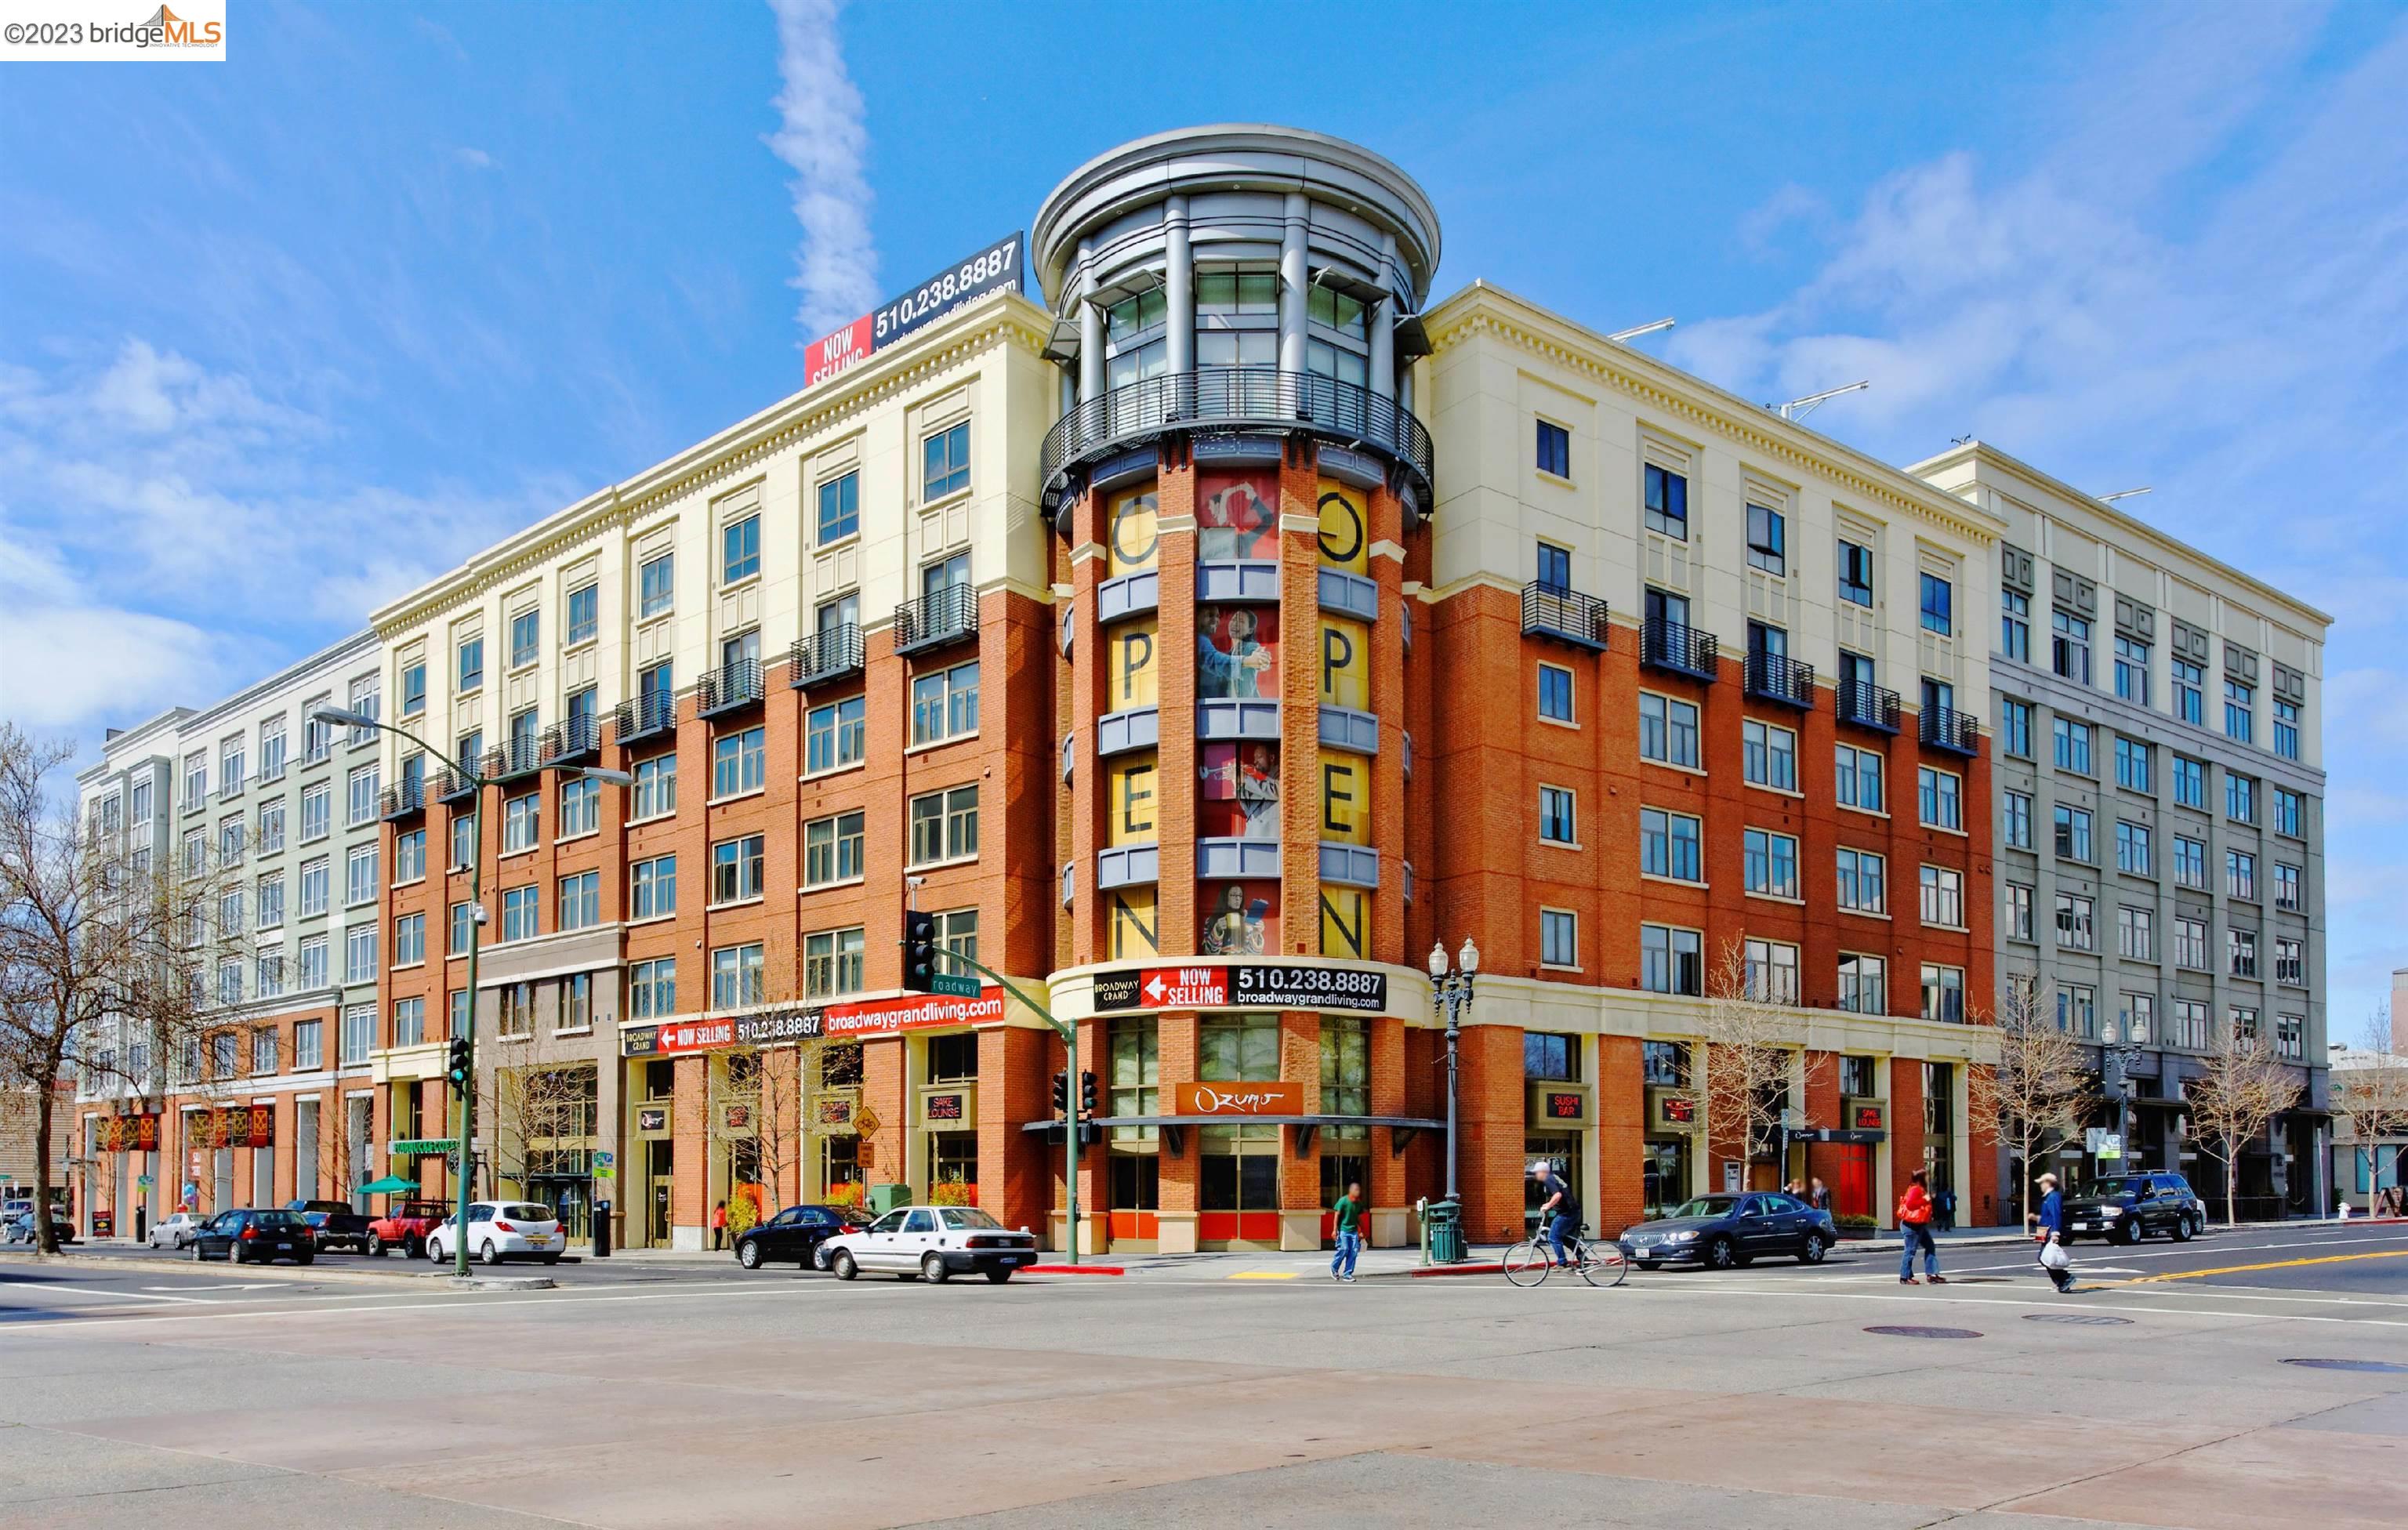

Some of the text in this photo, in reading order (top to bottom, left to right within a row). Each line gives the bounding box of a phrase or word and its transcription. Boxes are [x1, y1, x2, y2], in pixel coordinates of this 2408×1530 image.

[876, 241, 1017, 339] 510.238.8887
[824, 325, 853, 364] NOW
[1094, 980, 1139, 993] BROADWAY
[1180, 968, 1211, 987] NOW
[1238, 968, 1380, 995] 510.238.8887
[932, 980, 977, 996] roadway
[1103, 991, 1129, 1001] GRAND
[1168, 985, 1223, 1005] SELLING
[1237, 990, 1380, 1009] broadwaygrandliving.com
[828, 999, 1002, 1031] broadwaygrandliving.com
[677, 1024, 731, 1046] NOW SELLING
[934, 1097, 953, 1107] SAKE
[1554, 1095, 1579, 1104] SUSHI
[928, 1107, 960, 1118] LOUNGE
[1558, 1106, 1575, 1115] BAR
